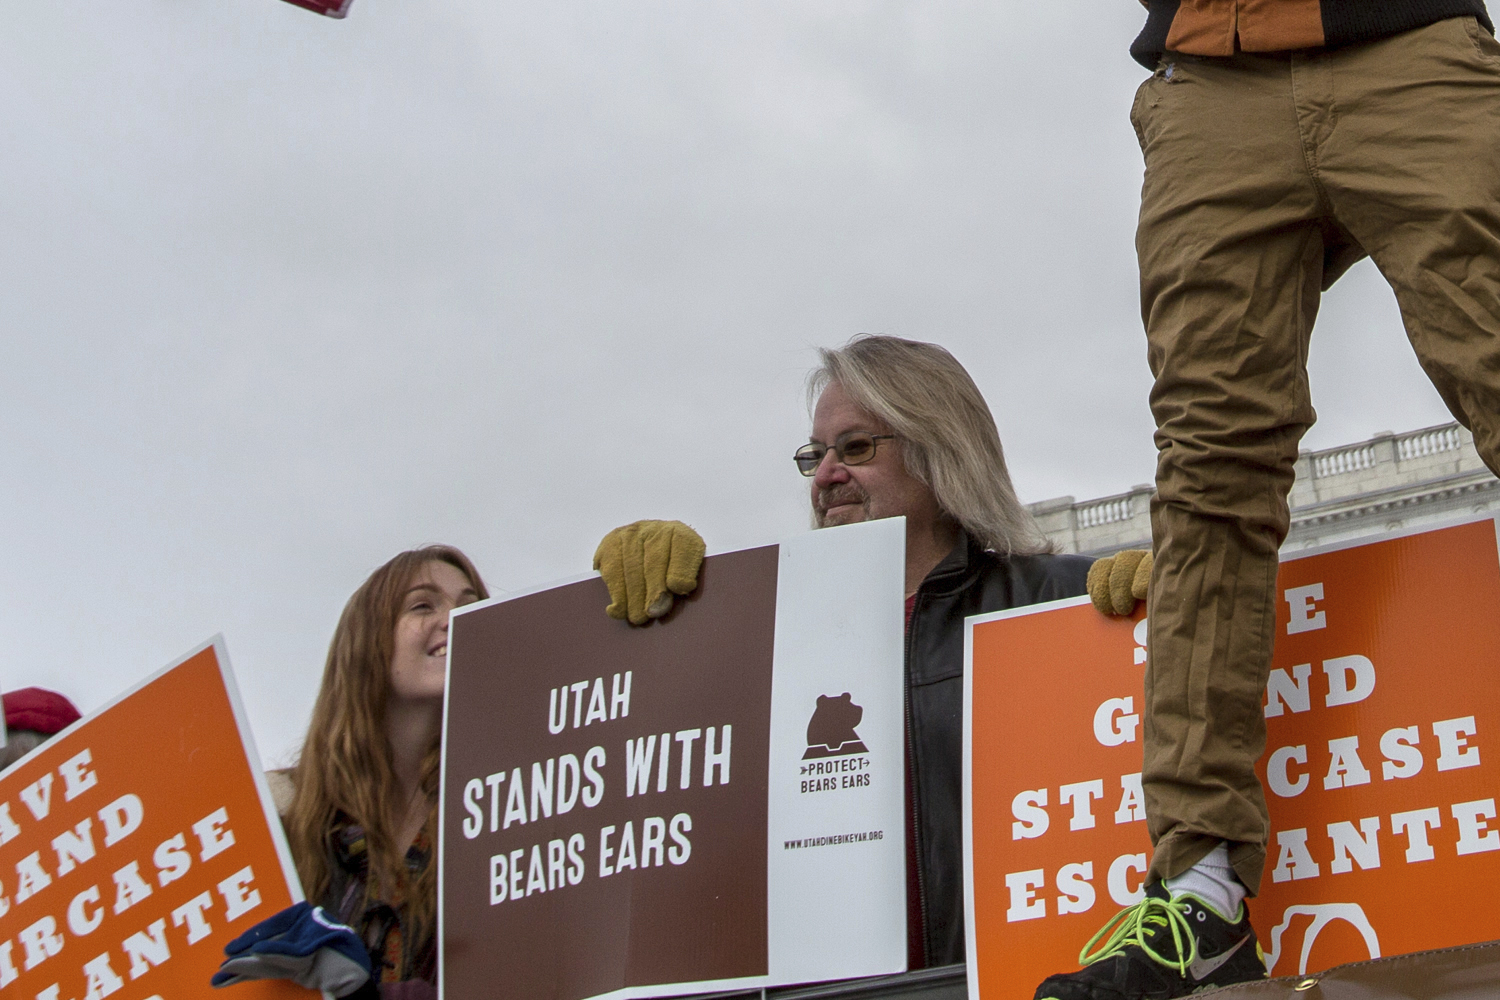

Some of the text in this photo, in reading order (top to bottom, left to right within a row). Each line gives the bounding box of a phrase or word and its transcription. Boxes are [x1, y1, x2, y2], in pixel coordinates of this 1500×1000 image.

[548, 671, 633, 735] UTAH
[462, 725, 732, 840] STANDS WITH
[800, 773, 871, 794] BEARS EARS
[808, 757, 864, 776] PROTECT
[1011, 715, 1481, 841] STACASE
[0, 793, 144, 918] AND
[489, 813, 693, 906] BEARS EARS
